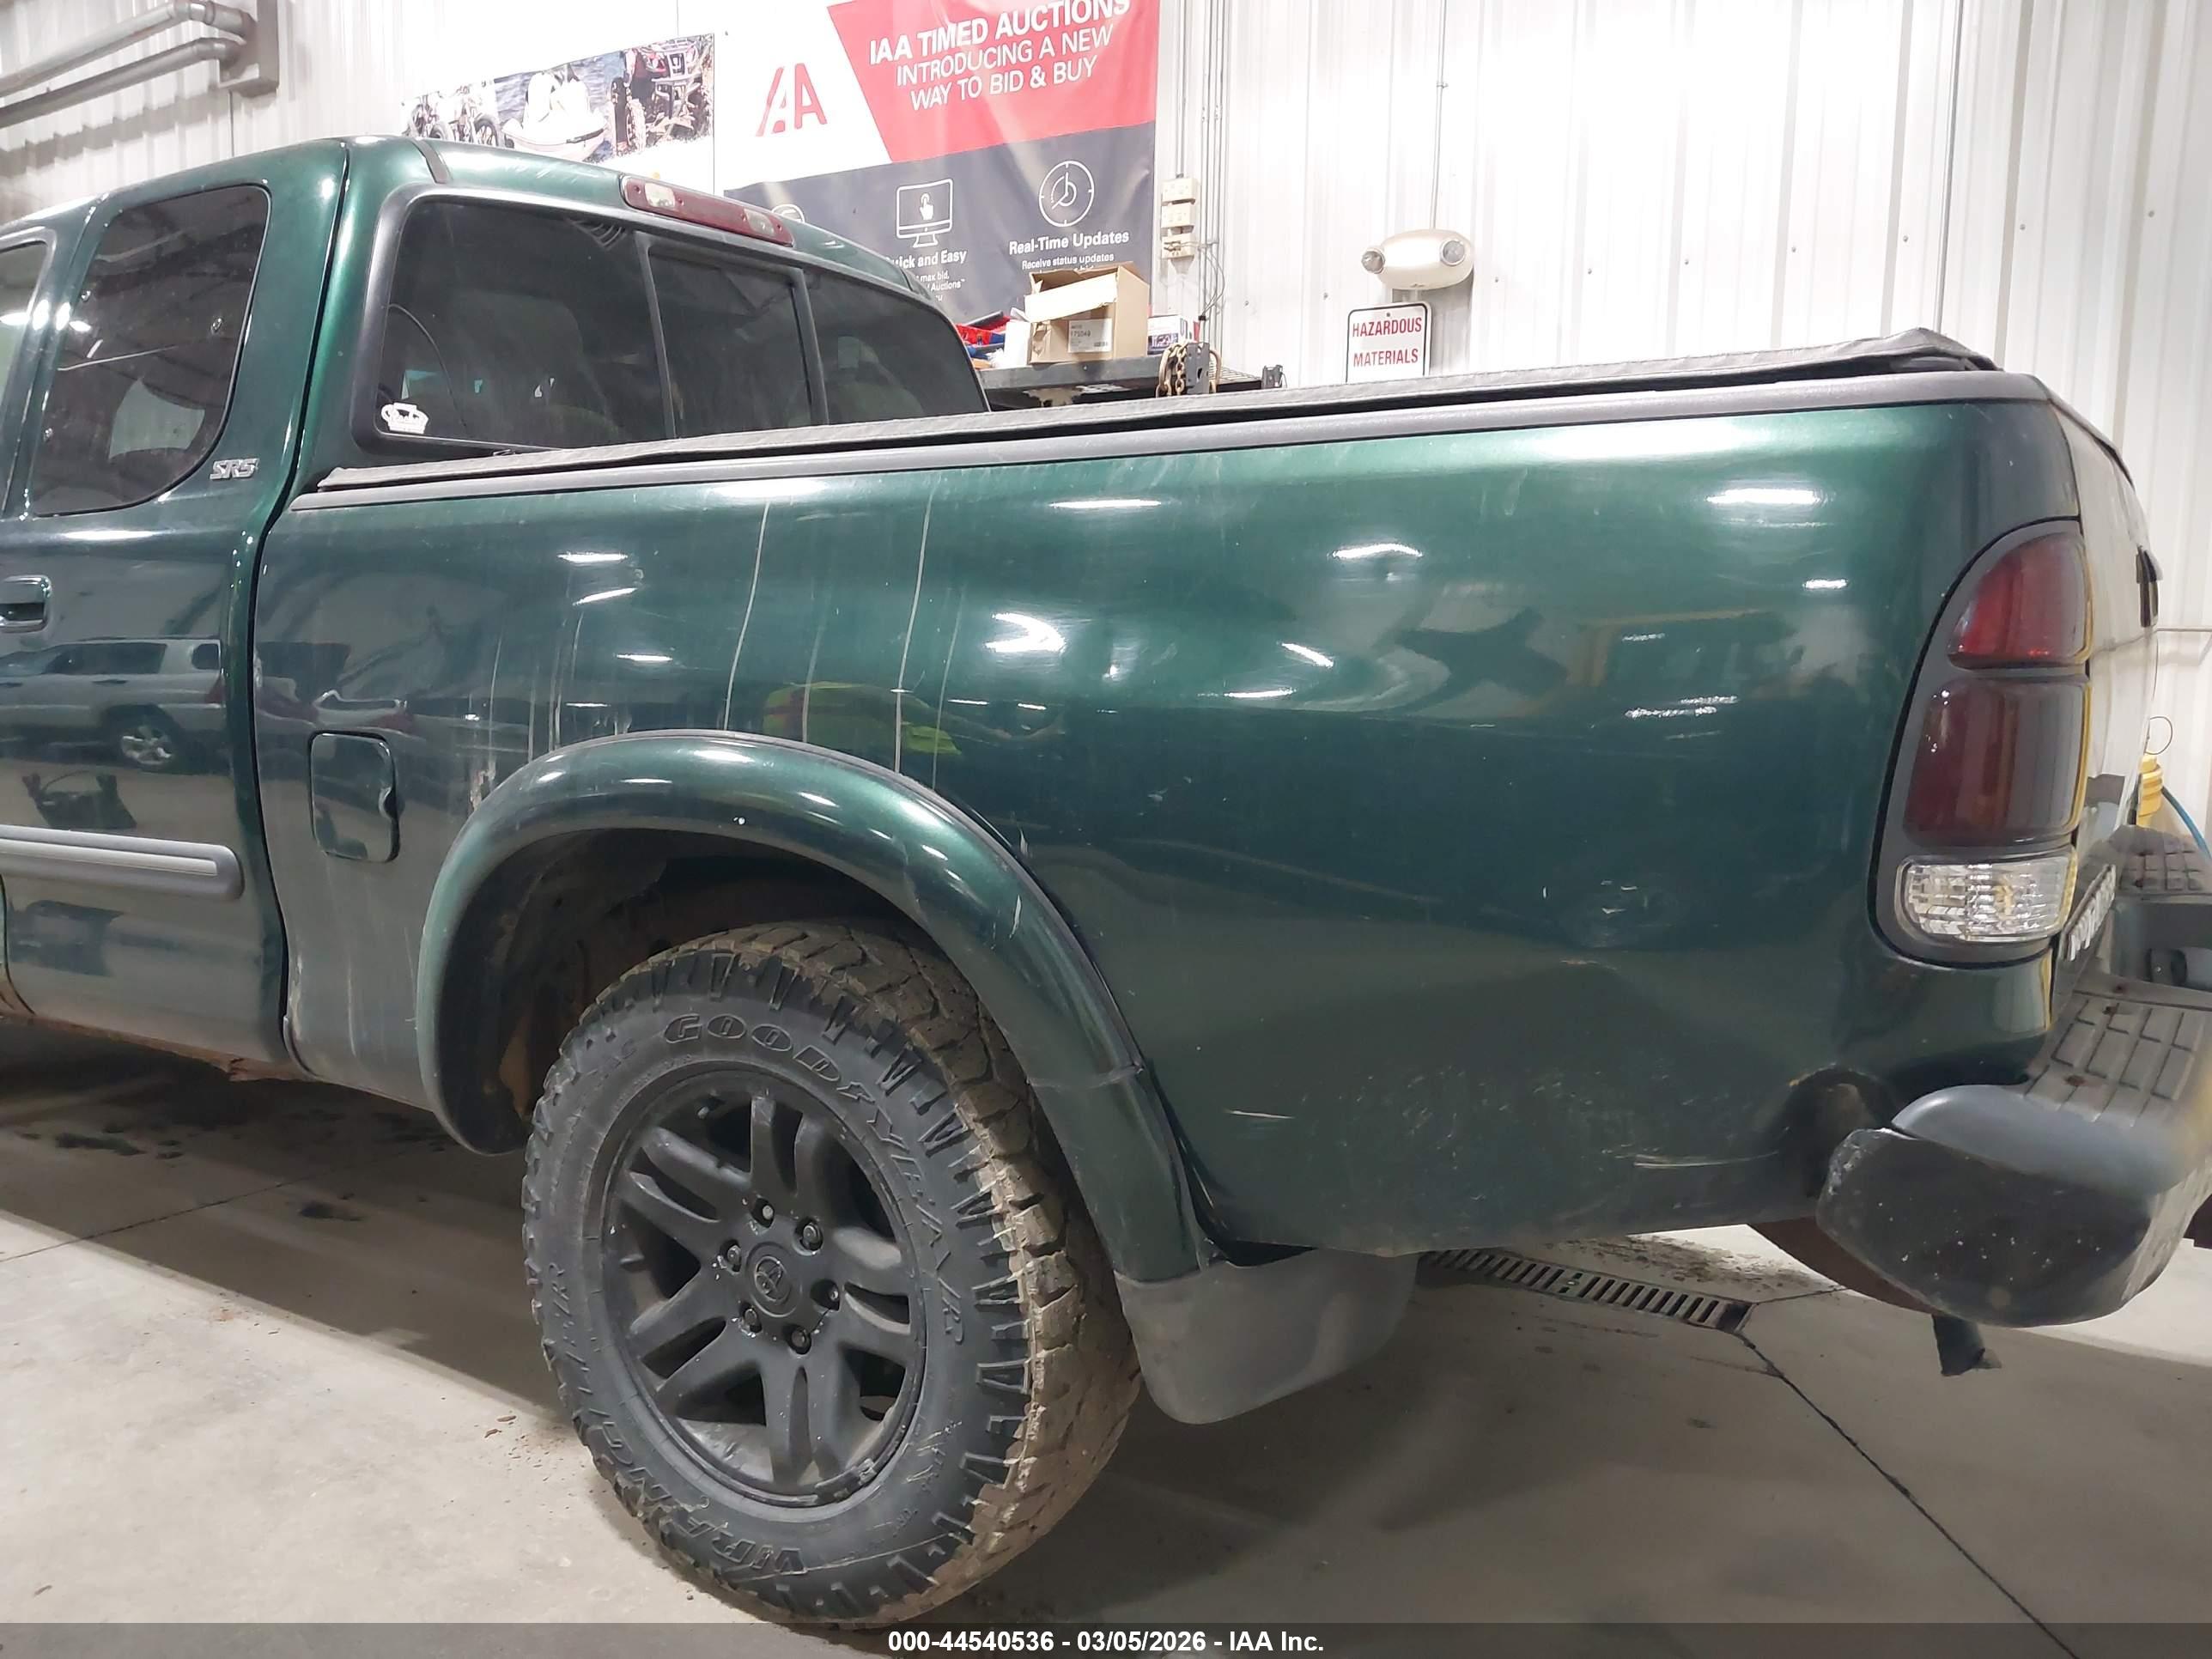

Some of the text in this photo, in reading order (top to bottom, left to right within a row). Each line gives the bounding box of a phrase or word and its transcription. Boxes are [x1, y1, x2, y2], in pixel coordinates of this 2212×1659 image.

[869, 0, 1132, 64] IAA TIMED AUCTIONS
[896, 23, 1114, 86] INTRODUCING A NEW
[910, 55, 1097, 110] WAY TO BID & BUY
[1009, 230, 1130, 255] Real-Time Updates
[888, 249, 967, 269] uick and Easy
[1022, 258, 1052, 270] Receive
[1052, 255, 1078, 266] status
[1079, 252, 1115, 264] updates
[921, 273, 937, 283] max
[1352, 317, 1422, 337] HAZARDOUS
[1352, 348, 1419, 368] MATERIALS
[663, 1013, 964, 1343] GOODYEAR
